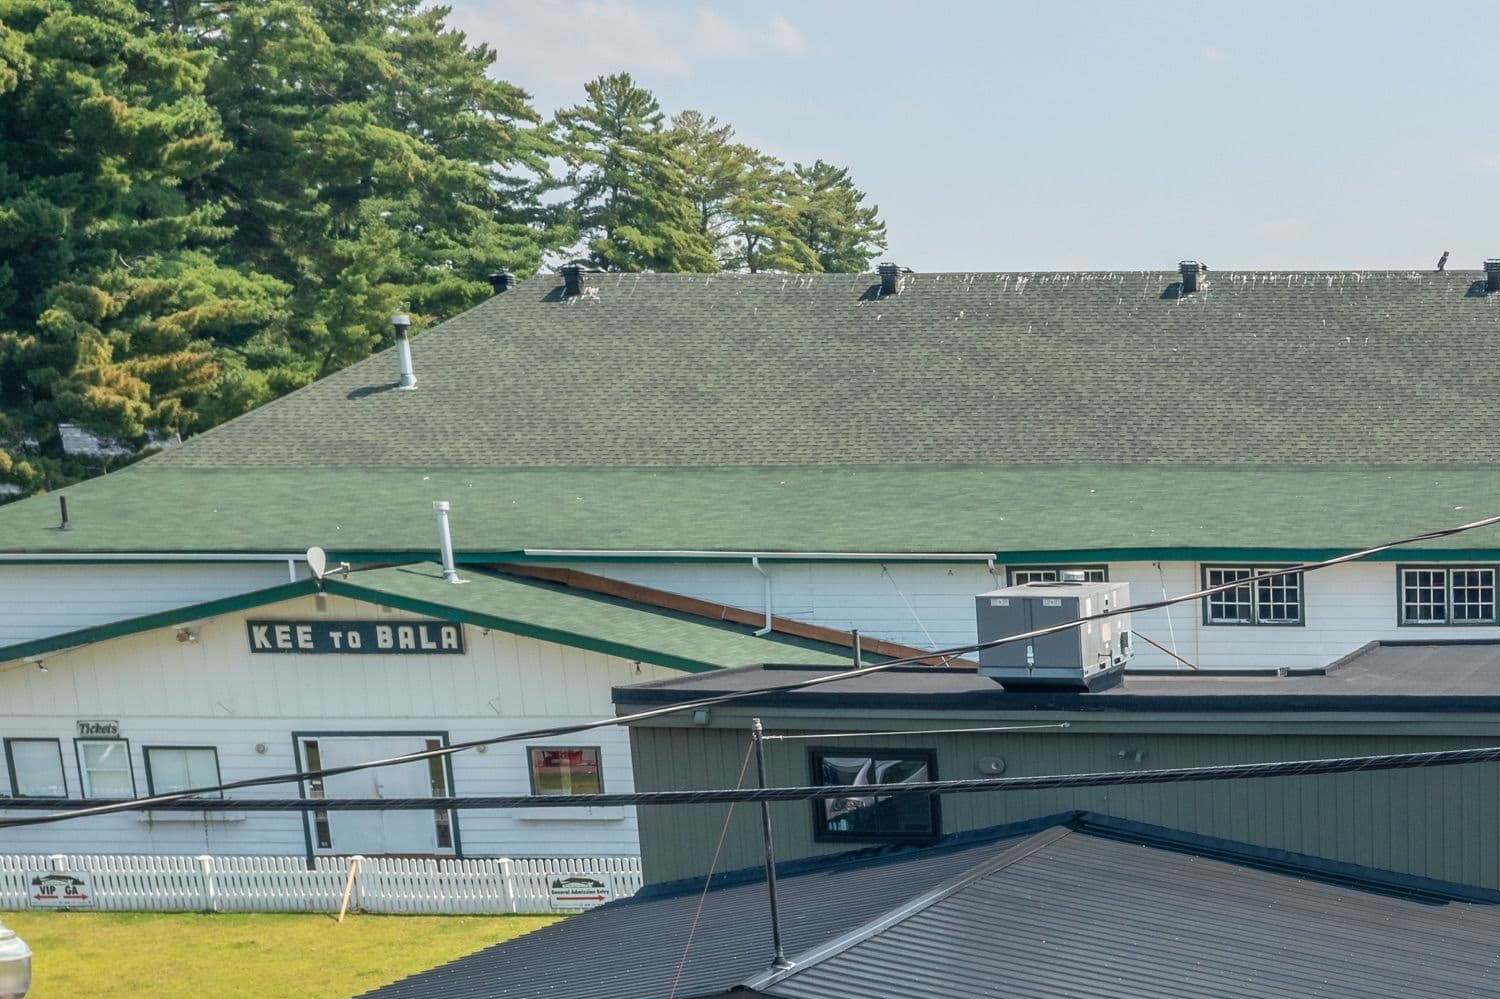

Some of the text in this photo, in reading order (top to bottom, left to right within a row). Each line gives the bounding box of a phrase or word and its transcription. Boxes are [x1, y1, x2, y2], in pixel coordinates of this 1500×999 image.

[252, 624, 314, 649] KEE
[376, 624, 459, 650] BALA
[80, 722, 118, 735] Tickets
[40, 885, 79, 895] VIP GA
